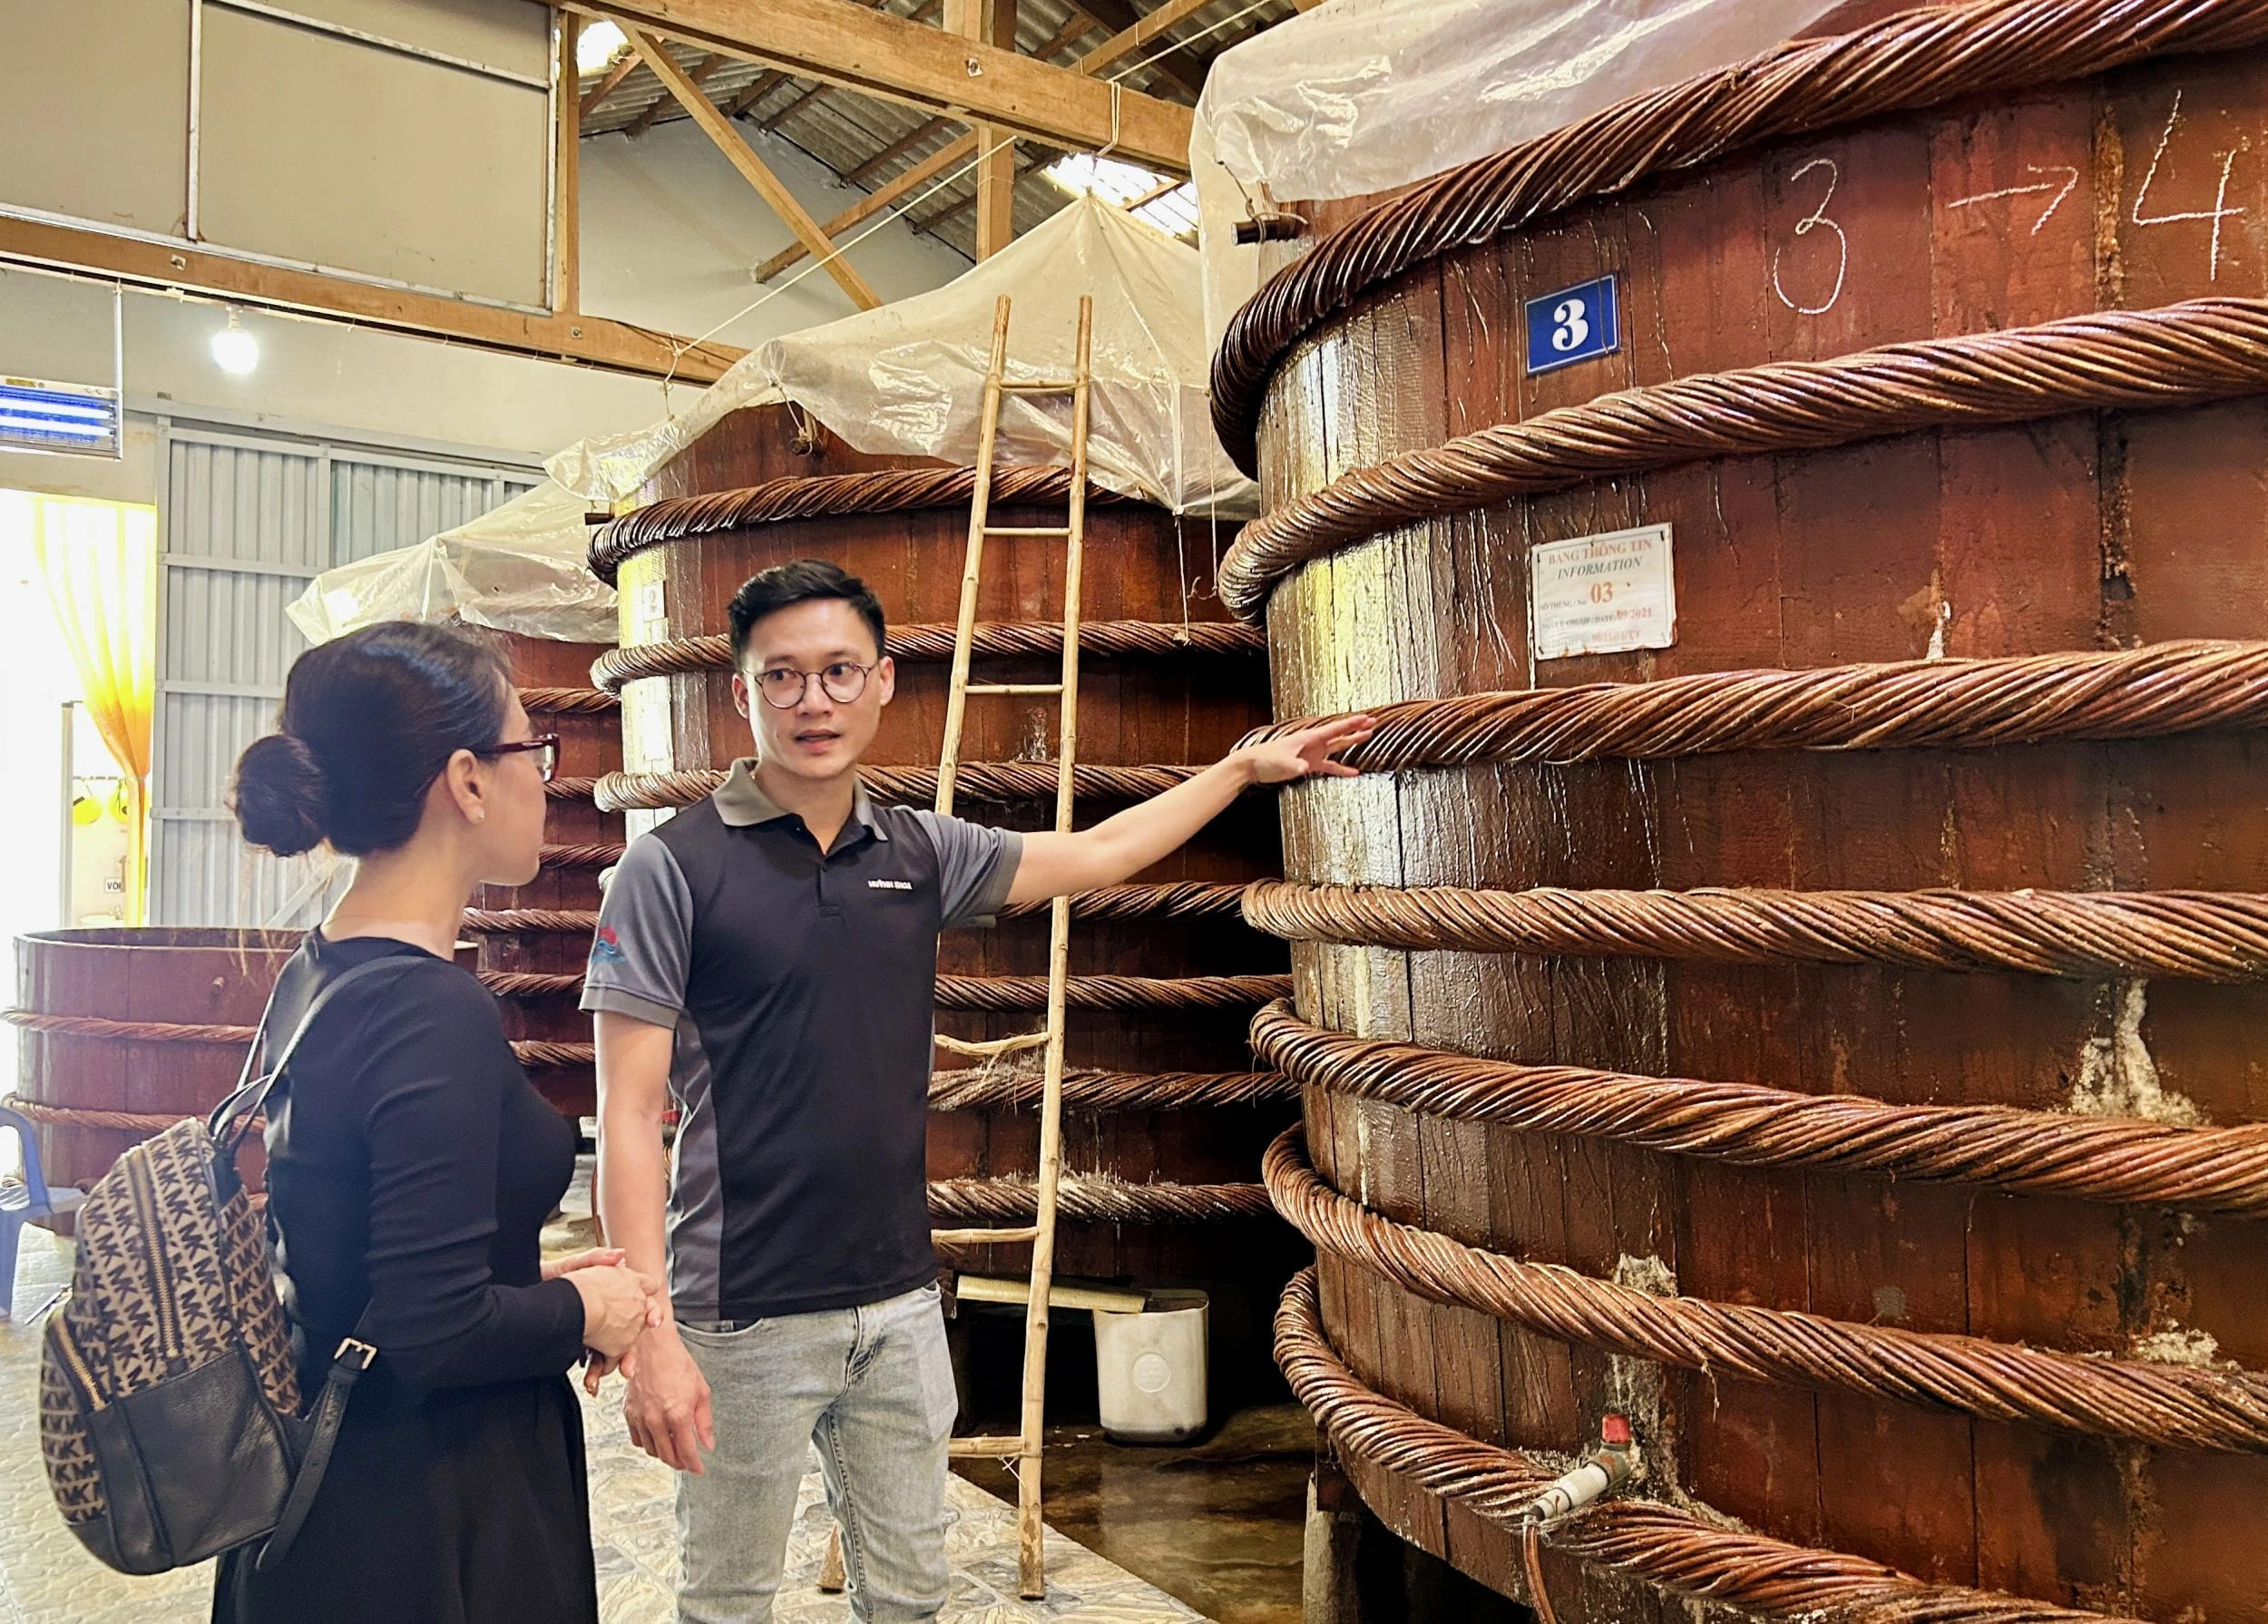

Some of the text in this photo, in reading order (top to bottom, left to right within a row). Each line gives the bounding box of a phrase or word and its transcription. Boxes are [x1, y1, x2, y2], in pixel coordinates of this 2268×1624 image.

[1773, 89, 2246, 315] 3 4
[1552, 298, 1589, 351] 3
[1631, 538, 1653, 553] TIN
[1557, 556, 1644, 580] INFORMATION
[1590, 582, 1614, 603] 03
